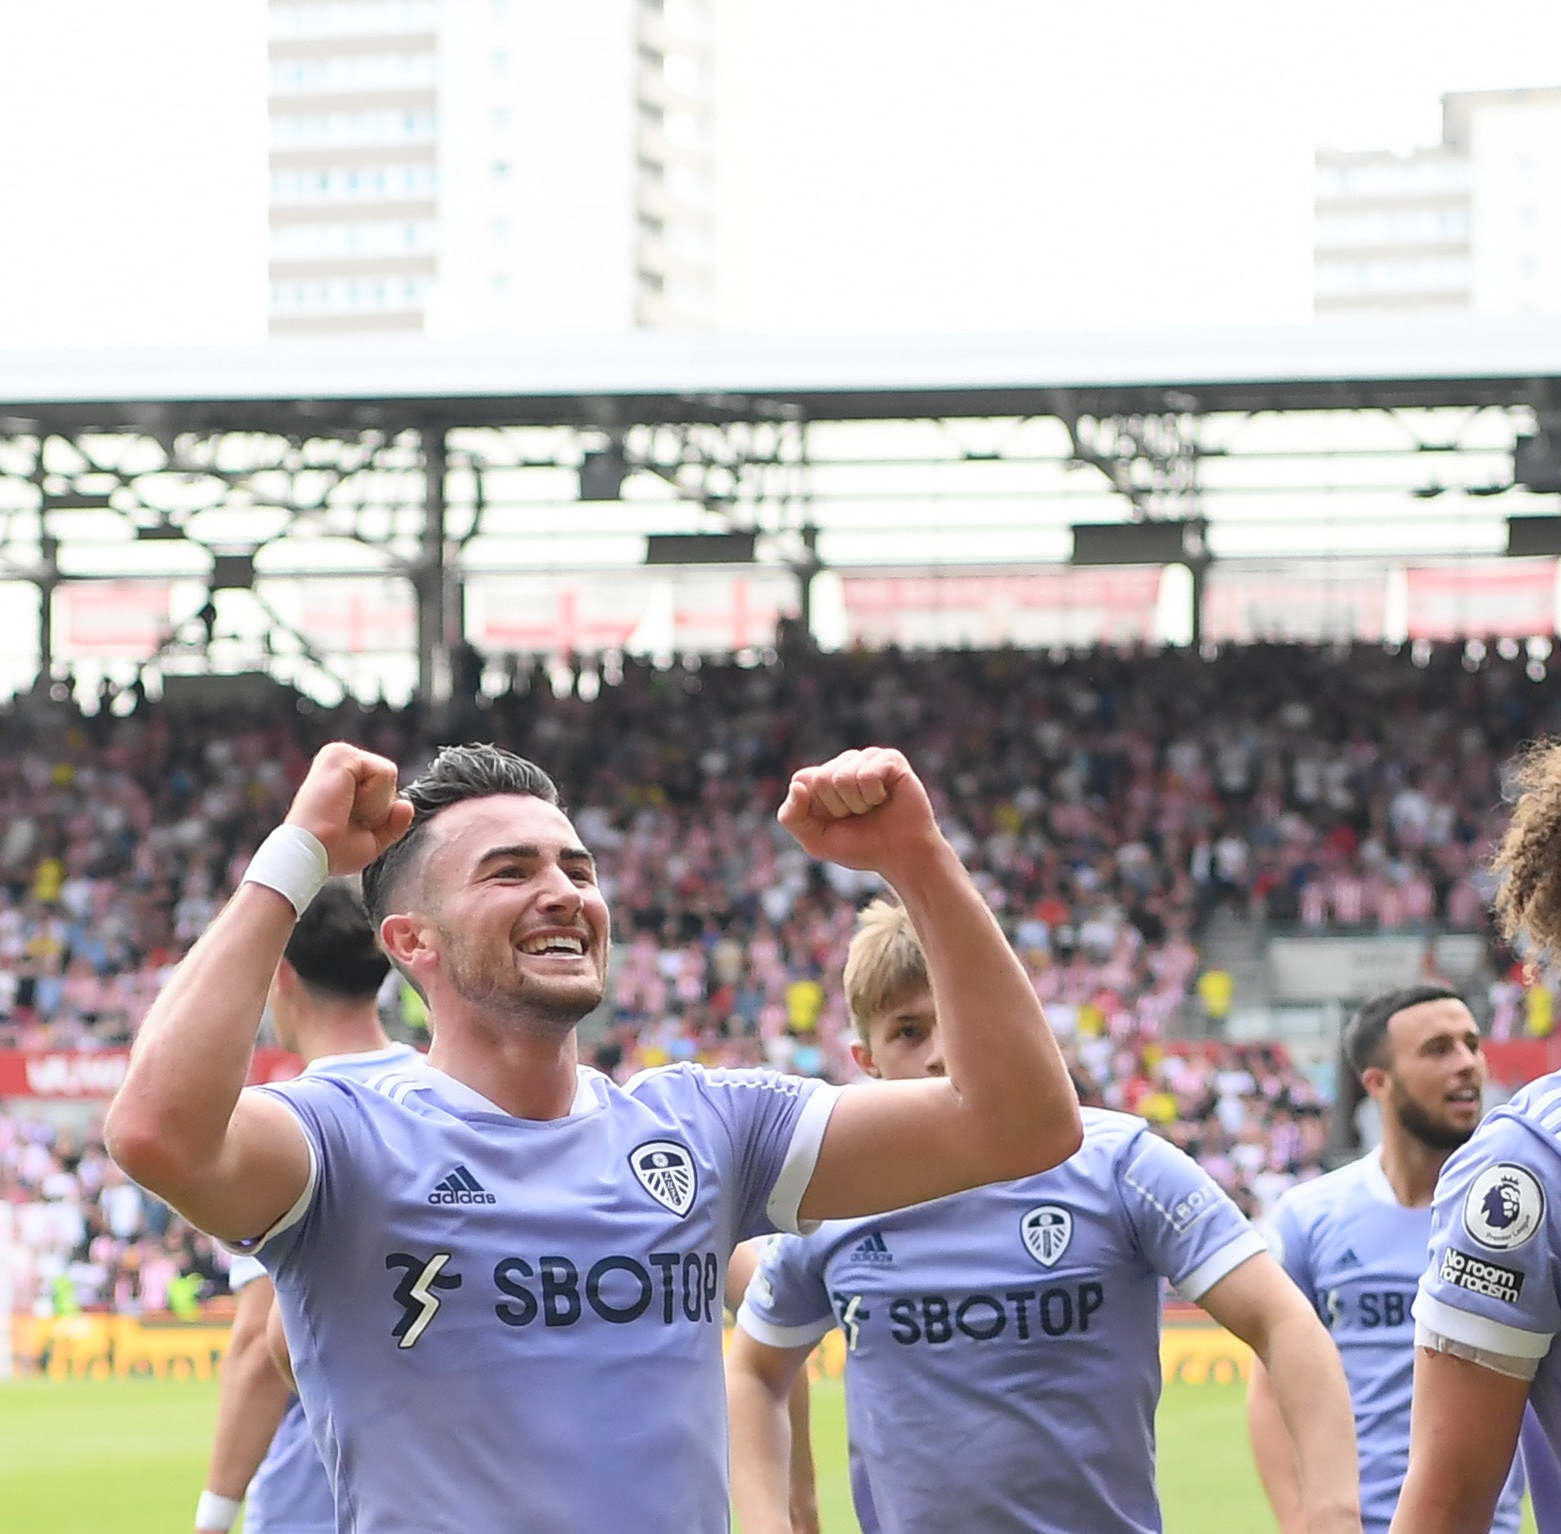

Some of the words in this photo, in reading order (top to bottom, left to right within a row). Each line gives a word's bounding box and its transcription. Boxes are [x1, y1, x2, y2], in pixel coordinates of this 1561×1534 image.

[427, 1190, 497, 1205] adidas
[1442, 1247, 1466, 1270] No
[1465, 1259, 1516, 1288] room
[1459, 1272, 1519, 1303] racism
[493, 1252, 718, 1328] SBOTOP
[889, 1282, 1105, 1346] SBOTOP
